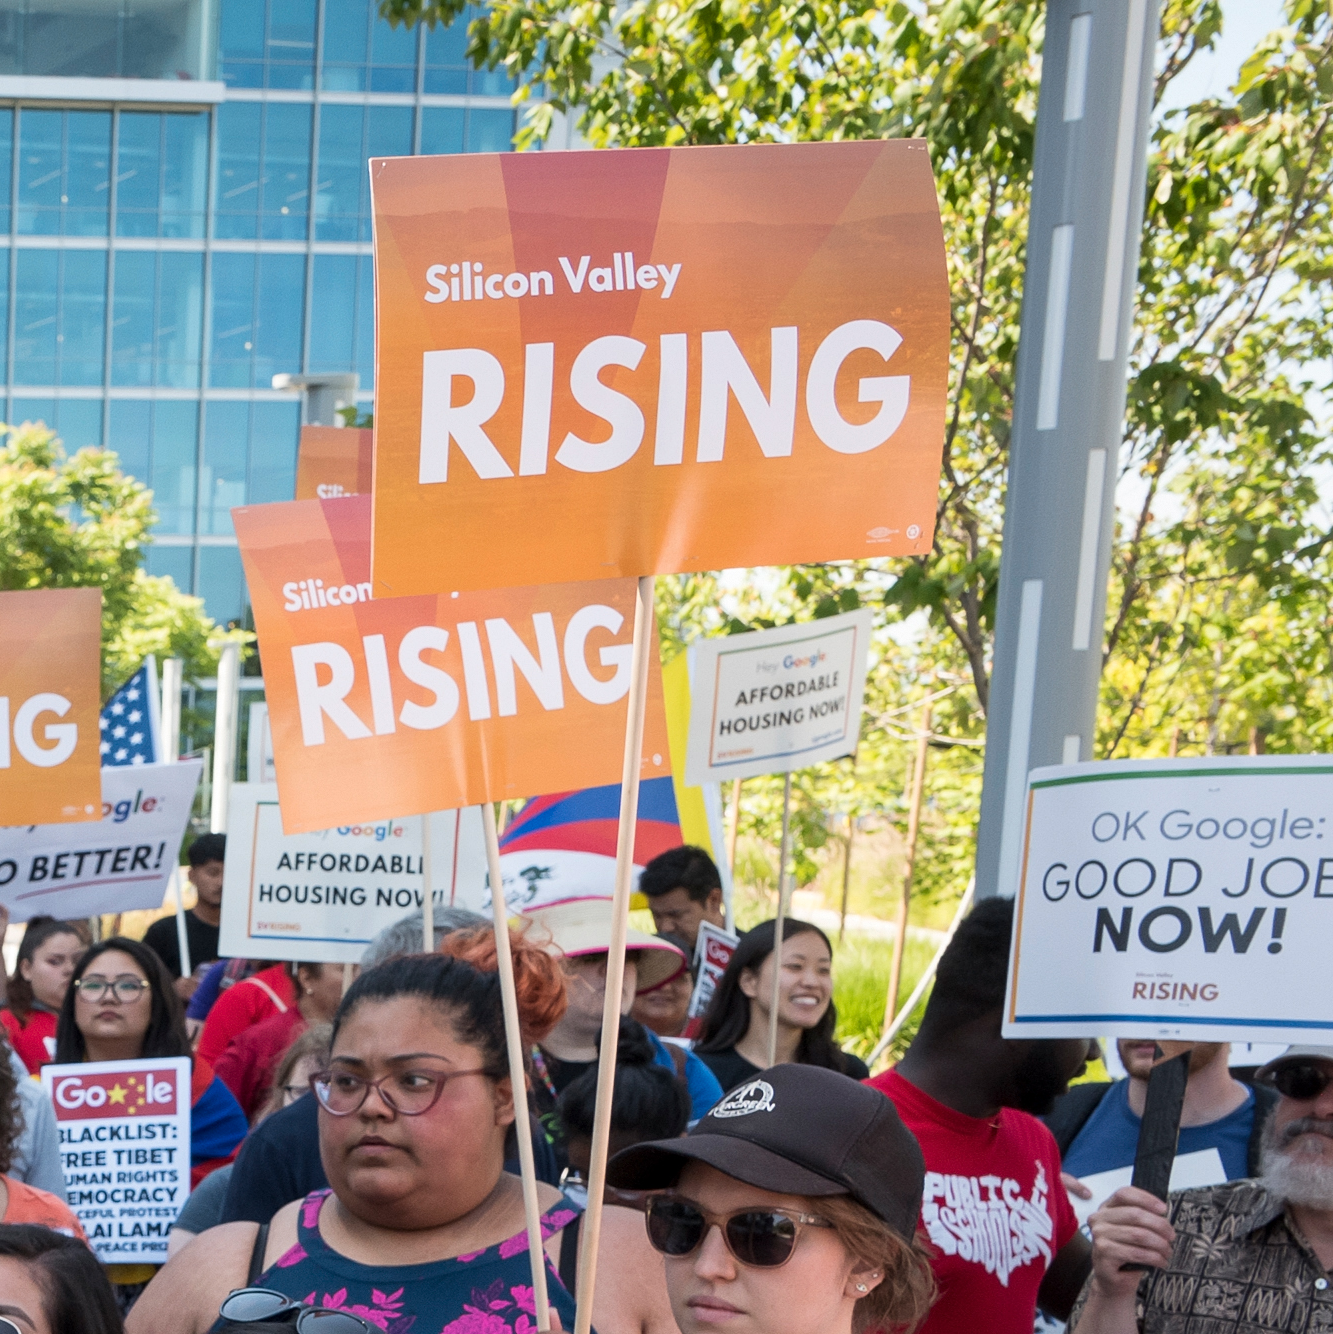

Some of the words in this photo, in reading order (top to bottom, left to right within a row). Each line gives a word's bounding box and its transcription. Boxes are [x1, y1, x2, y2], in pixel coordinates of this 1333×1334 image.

[425, 261, 553, 303] Silicon
[559, 252, 681, 298] Valley
[419, 319, 910, 484] RISING
[283, 578, 372, 611] Silicon
[290, 604, 634, 746] RISING
[736, 671, 839, 706] AFFORDABLE
[719, 709, 804, 736] HOUSING
[810, 696, 845, 720] NOW!
[1092, 810, 1149, 842] OK
[1160, 809, 1326, 848] Google:
[29, 842, 166, 882] BETTER!
[1043, 857, 1202, 901] GOOD
[259, 884, 366, 905] HOUSING
[1093, 905, 1287, 954] NOW!
[1132, 982, 1219, 1001] RISING
[113, 1148, 177, 1165] TIBET
[117, 1169, 178, 1183] RIGHTS
[67, 1187, 178, 1206] EMOCRACY
[924, 1171, 1021, 1210] PUBLIC
[120, 1206, 178, 1217] PROTEST
